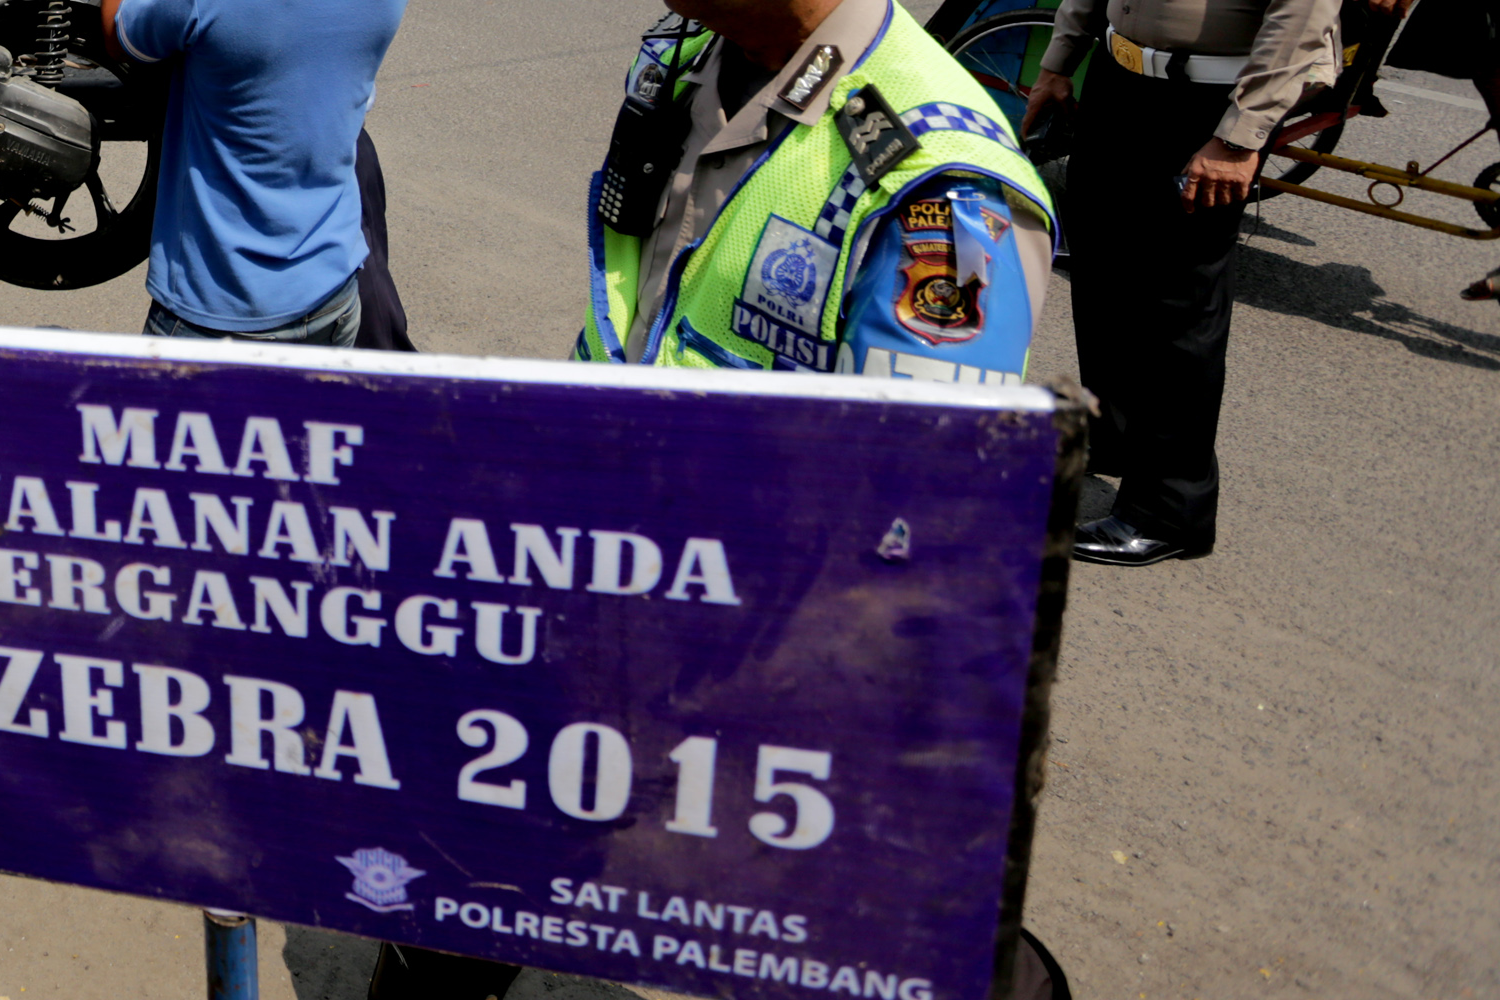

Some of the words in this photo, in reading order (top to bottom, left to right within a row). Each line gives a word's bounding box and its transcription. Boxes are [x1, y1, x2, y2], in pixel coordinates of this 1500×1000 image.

[732, 303, 829, 371] POLISI
[757, 294, 804, 326] POLRI
[77, 402, 364, 485] MAAF
[433, 518, 742, 605] ANDA
[456, 708, 835, 850] 2015
[435, 897, 641, 957] POLRESTA
[653, 935, 933, 1000] PALEMBANG
[550, 877, 628, 913] SAT
[637, 891, 808, 943] LANTAS
